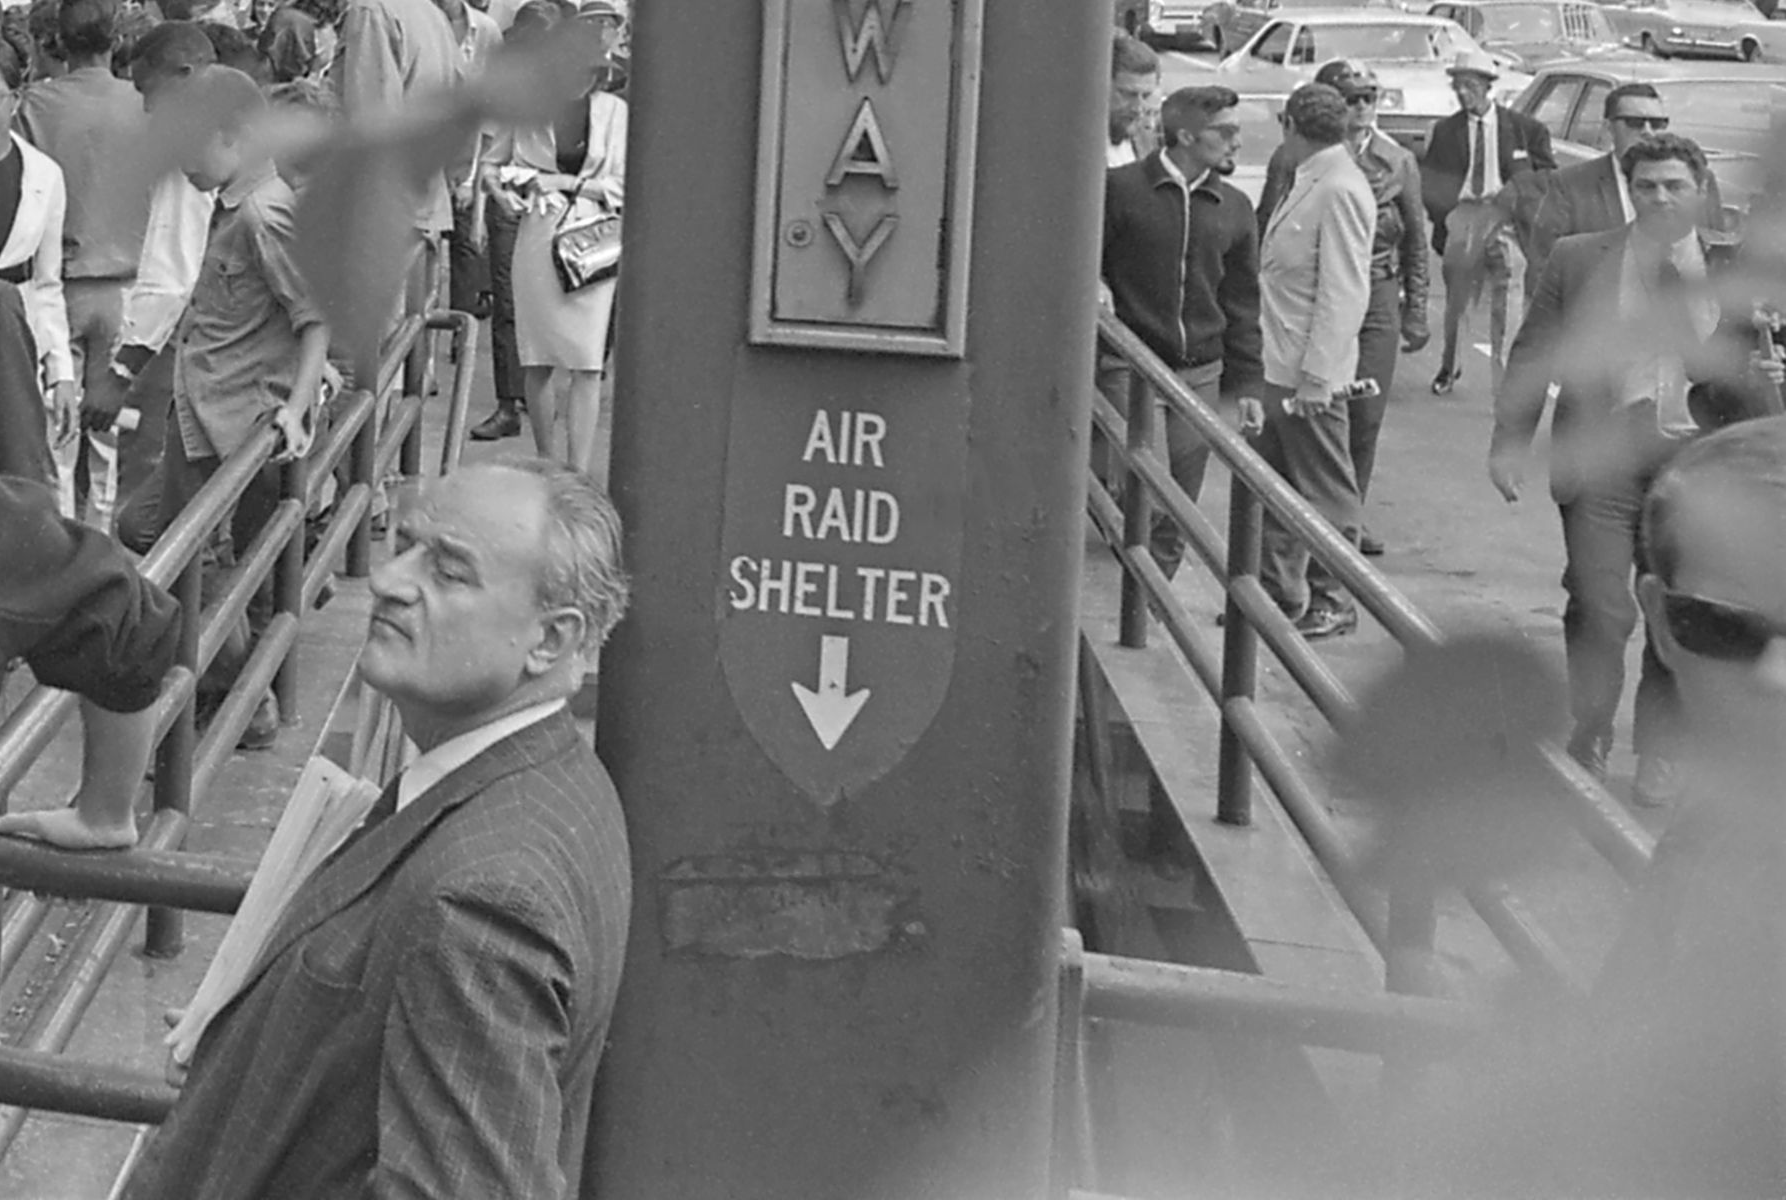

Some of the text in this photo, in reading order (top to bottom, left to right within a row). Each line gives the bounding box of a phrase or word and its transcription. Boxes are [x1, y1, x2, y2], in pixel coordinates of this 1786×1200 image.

[802, 408, 887, 468] AIR
[782, 483, 901, 545] RAID
[729, 555, 951, 629] SHELTER
